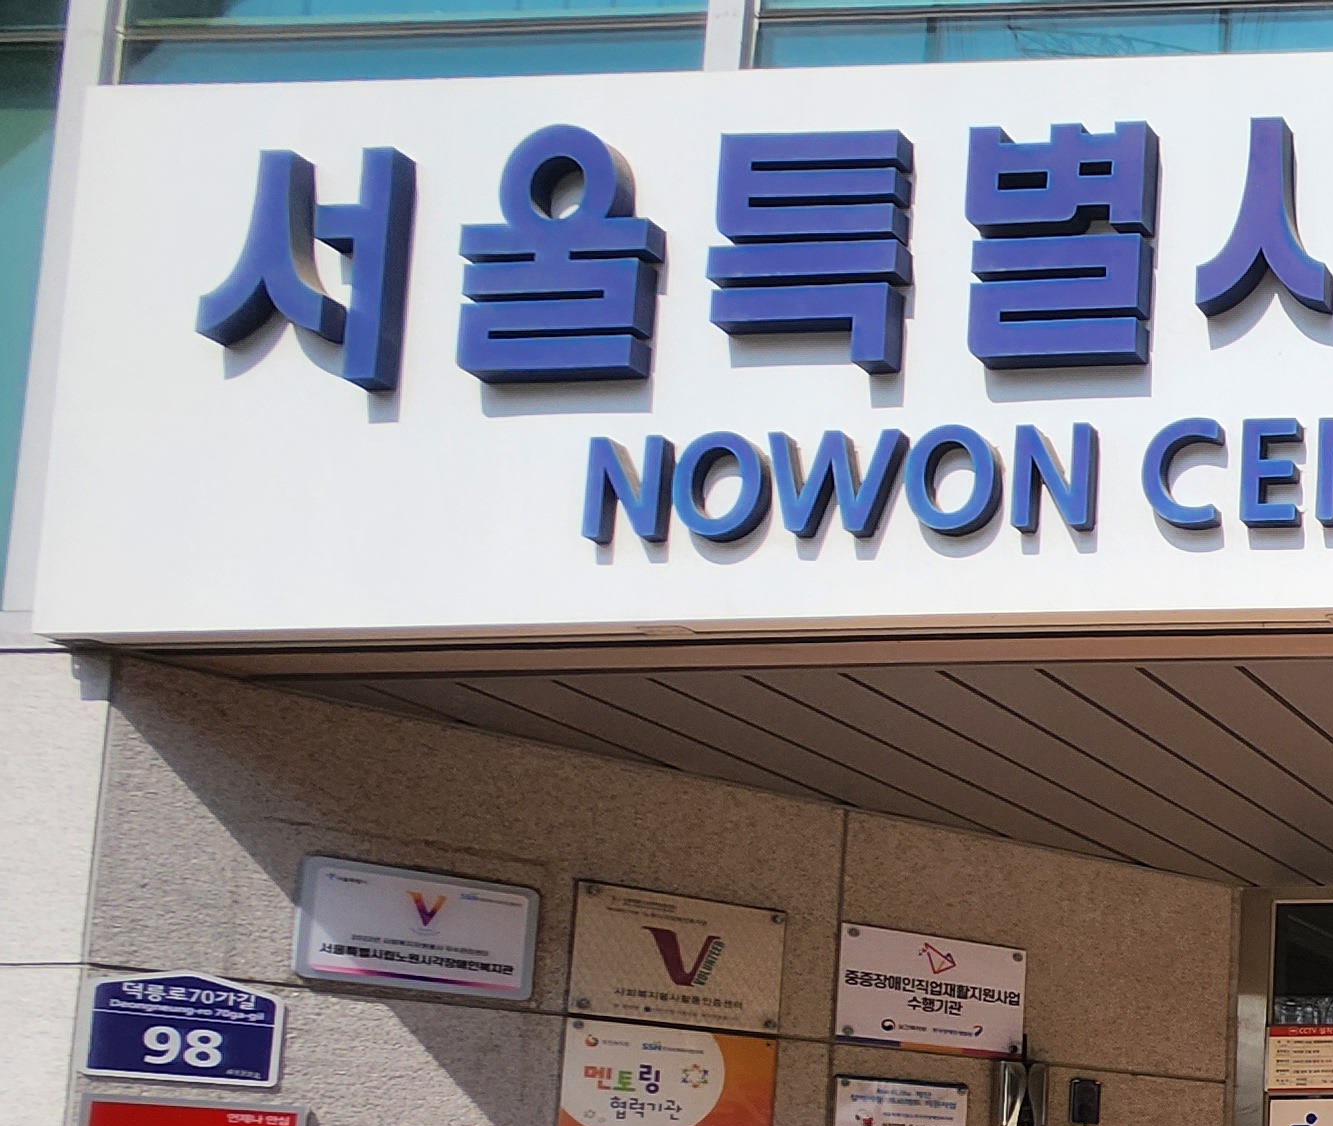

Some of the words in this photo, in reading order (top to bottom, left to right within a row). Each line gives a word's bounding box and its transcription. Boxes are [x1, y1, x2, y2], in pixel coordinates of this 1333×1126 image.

[581, 421, 1098, 544] NOWON
[693, 939, 725, 986] VOLUNTEER
[122, 982, 256, 1010] 덕릉로70가길
[845, 969, 1021, 1007] 중증장애인직업재활지원사업
[907, 997, 963, 1016] 수행기관
[143, 1025, 223, 1068] 98
[584, 1064, 660, 1094] 멘토링
[610, 1096, 682, 1120] 협력기관
